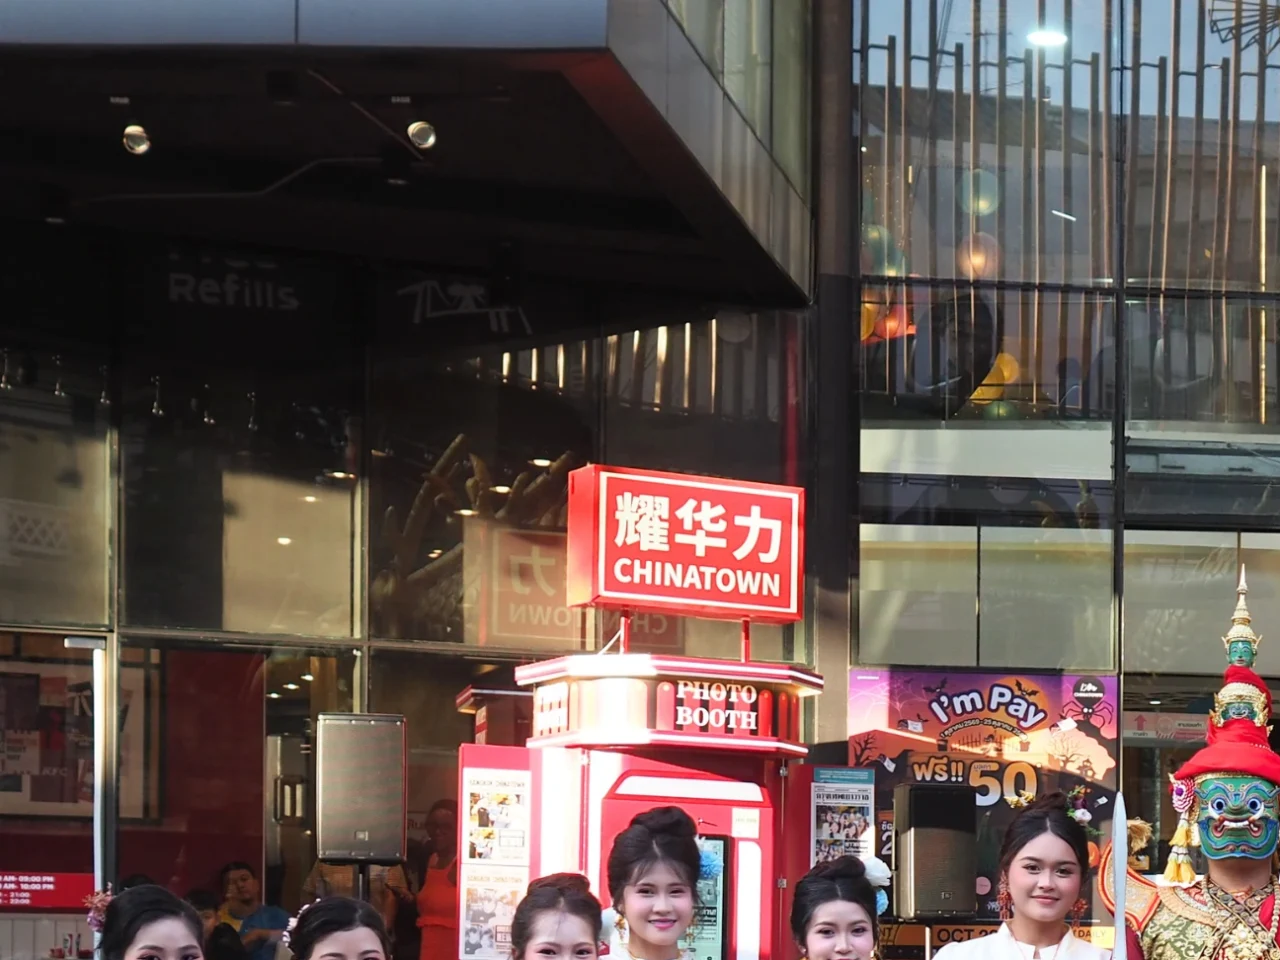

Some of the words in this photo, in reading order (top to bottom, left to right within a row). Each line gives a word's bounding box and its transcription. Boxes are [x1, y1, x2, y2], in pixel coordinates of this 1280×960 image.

[169, 272, 299, 311] Refills
[613, 491, 783, 564] 耀华力
[613, 557, 780, 598] CHINATOWN
[676, 679, 758, 704] PHOTO
[989, 685, 1046, 728] Pay
[675, 706, 758, 730] BOOTH
[912, 756, 963, 782] ฟรี!!
[969, 761, 1038, 807] 50
[937, 929, 975, 942] OCT
[1078, 929, 1106, 938] DAILY
